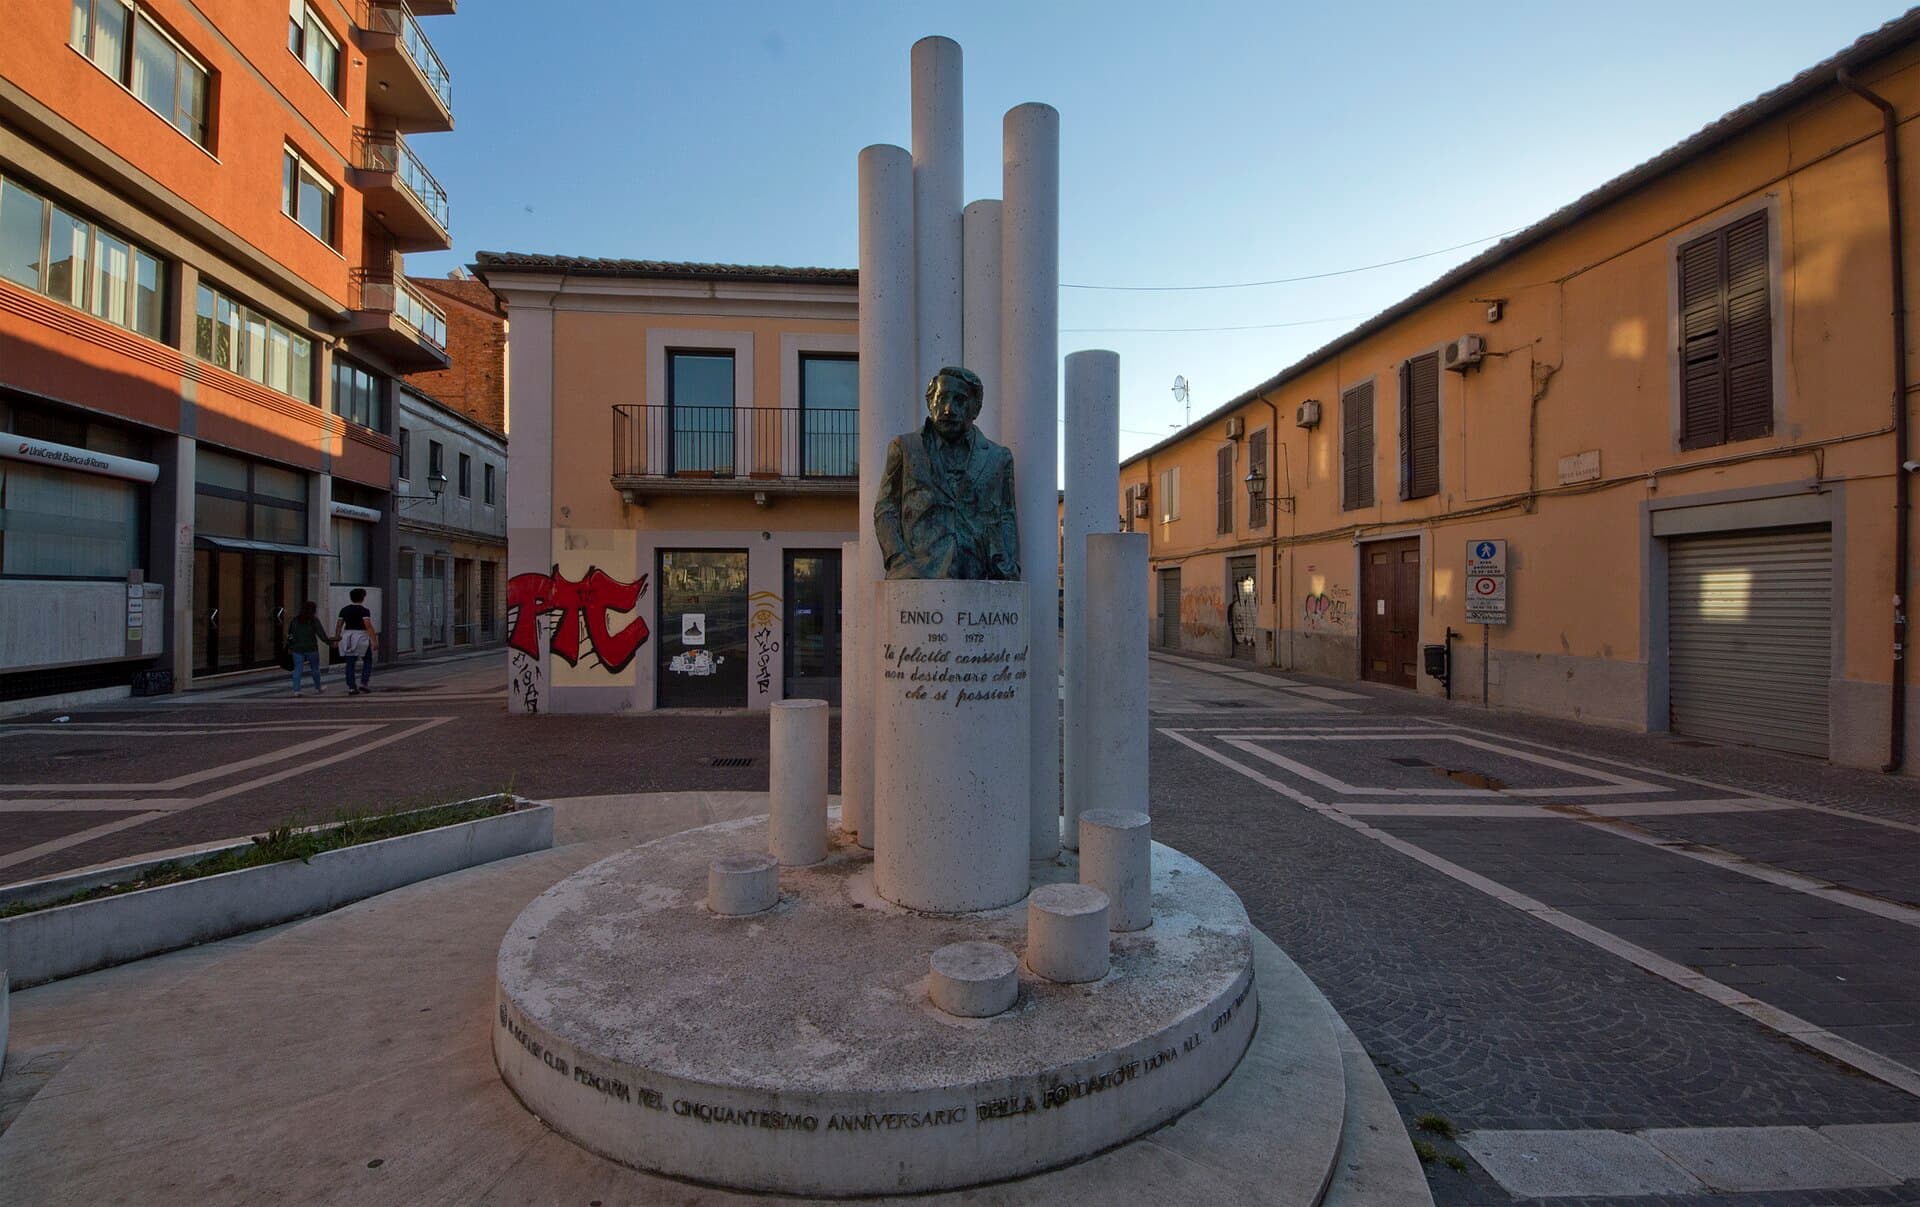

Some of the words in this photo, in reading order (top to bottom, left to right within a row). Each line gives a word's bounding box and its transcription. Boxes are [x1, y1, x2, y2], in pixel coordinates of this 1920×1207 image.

[29, 446, 62, 460] UniCredit
[64, 452, 84, 466] Banca
[90, 457, 110, 470] Roma
[900, 611, 943, 625] ENNIO
[957, 612, 1018, 626] FLAIANO
[928, 633, 948, 643] 1910
[965, 633, 984, 643] 1972
[885, 668, 905, 679] non
[905, 685, 928, 700] che
[934, 692, 947, 700] si
[574, 1066, 630, 1104] PESCARA
[672, 1099, 819, 1132] CINQUANTESIMO
[827, 1104, 966, 1131] ANNIVERSARIO
[976, 1096, 1036, 1121] DELLA
[1144, 1046, 1178, 1074] DONA
